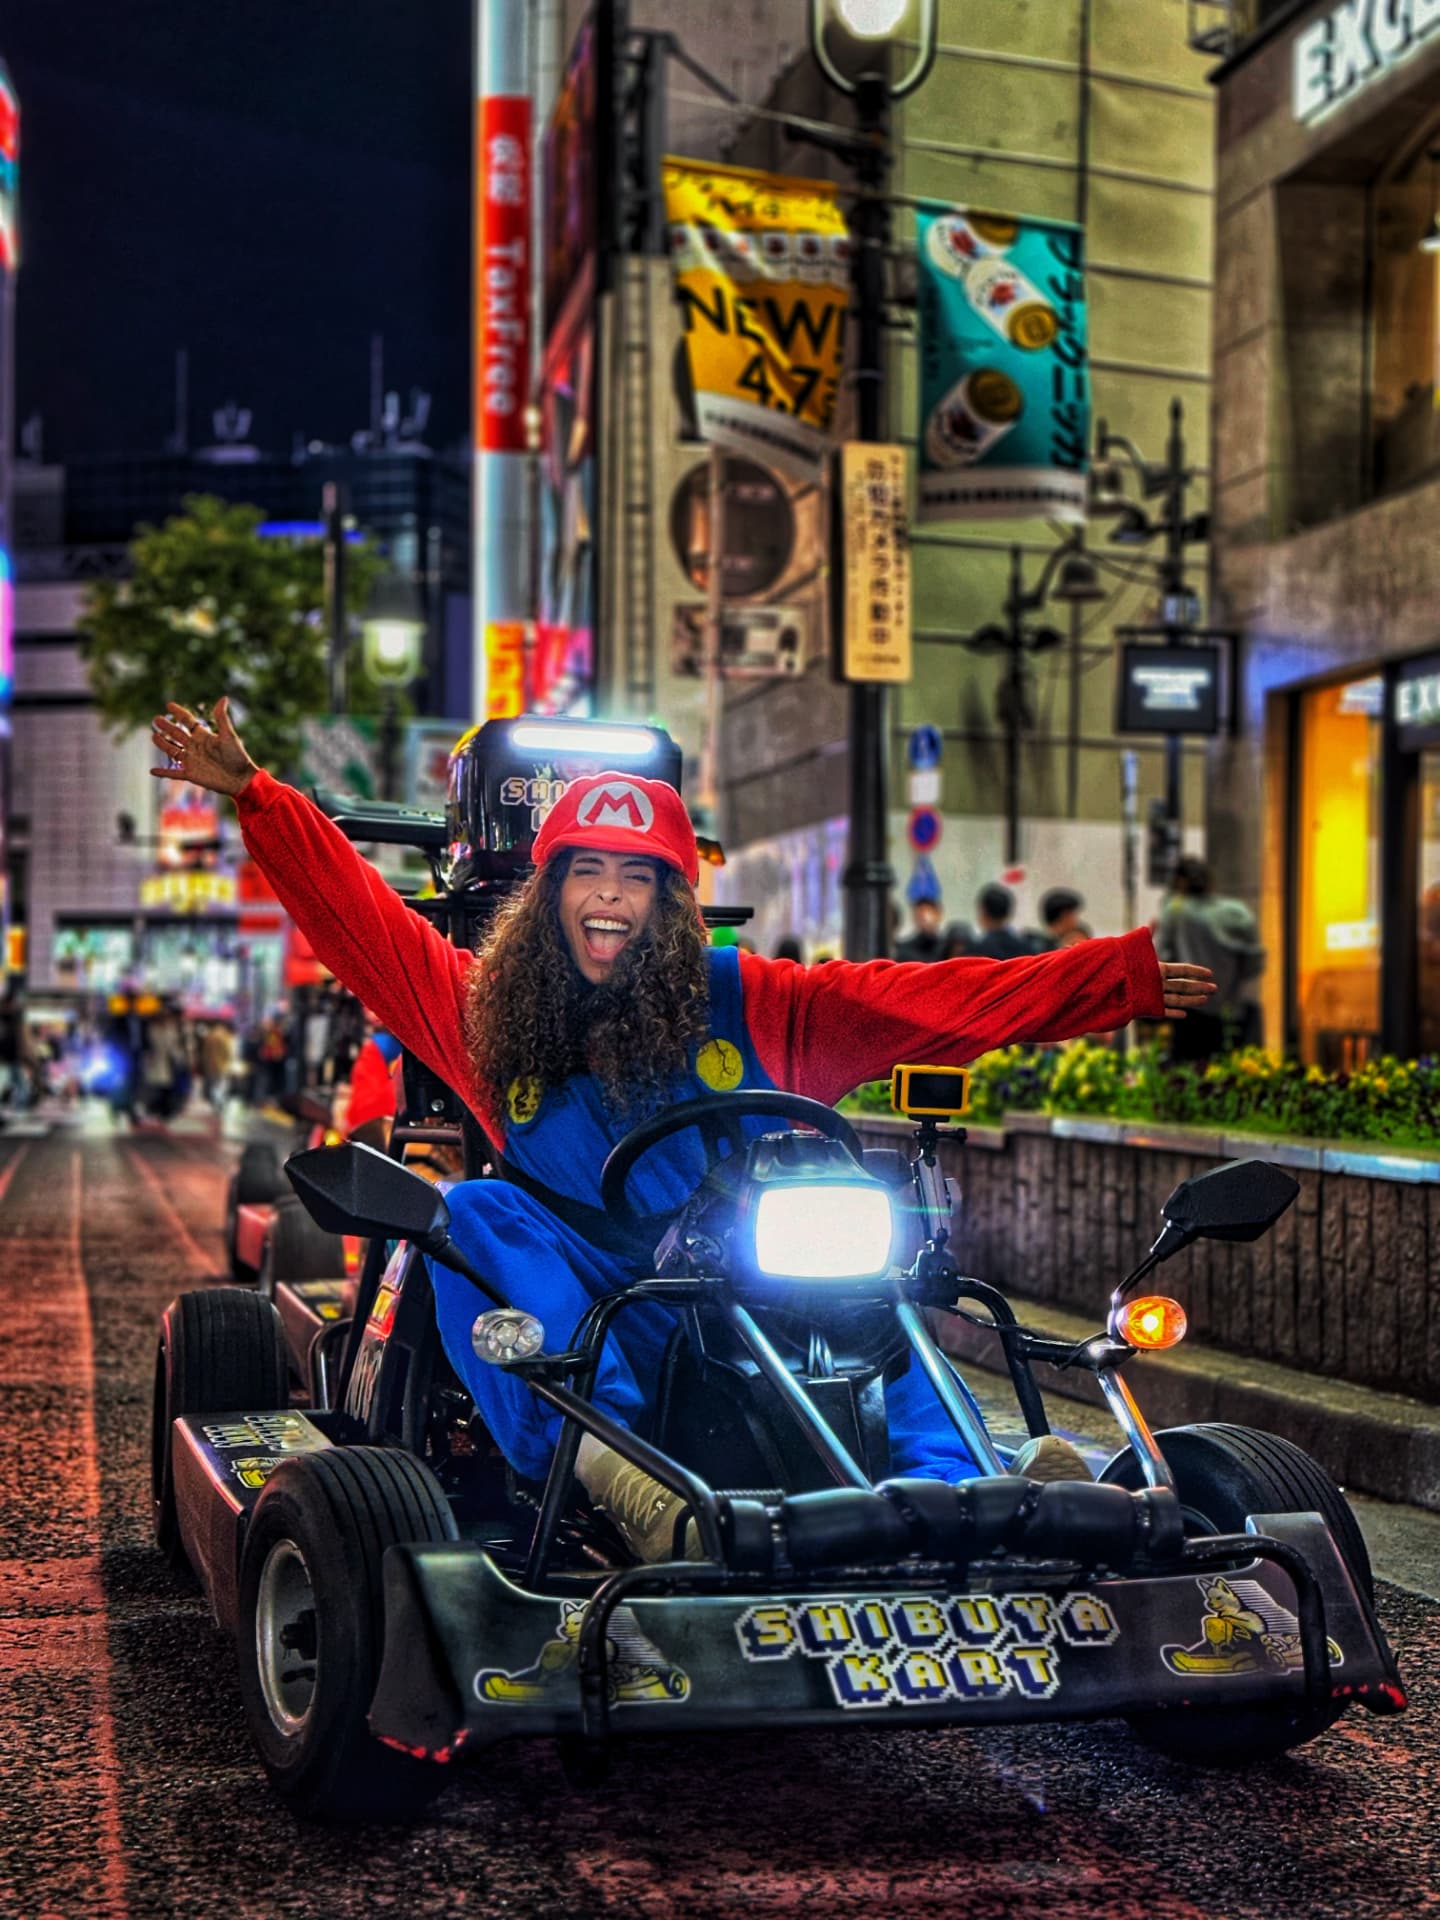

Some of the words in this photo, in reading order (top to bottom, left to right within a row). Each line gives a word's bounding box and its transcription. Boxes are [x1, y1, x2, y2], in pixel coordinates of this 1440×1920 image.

[1395, 676, 1440, 722] EX
[584, 790, 645, 827] M
[736, 1593, 1120, 1662] SHIBUYA
[827, 1647, 1060, 1709] KART
